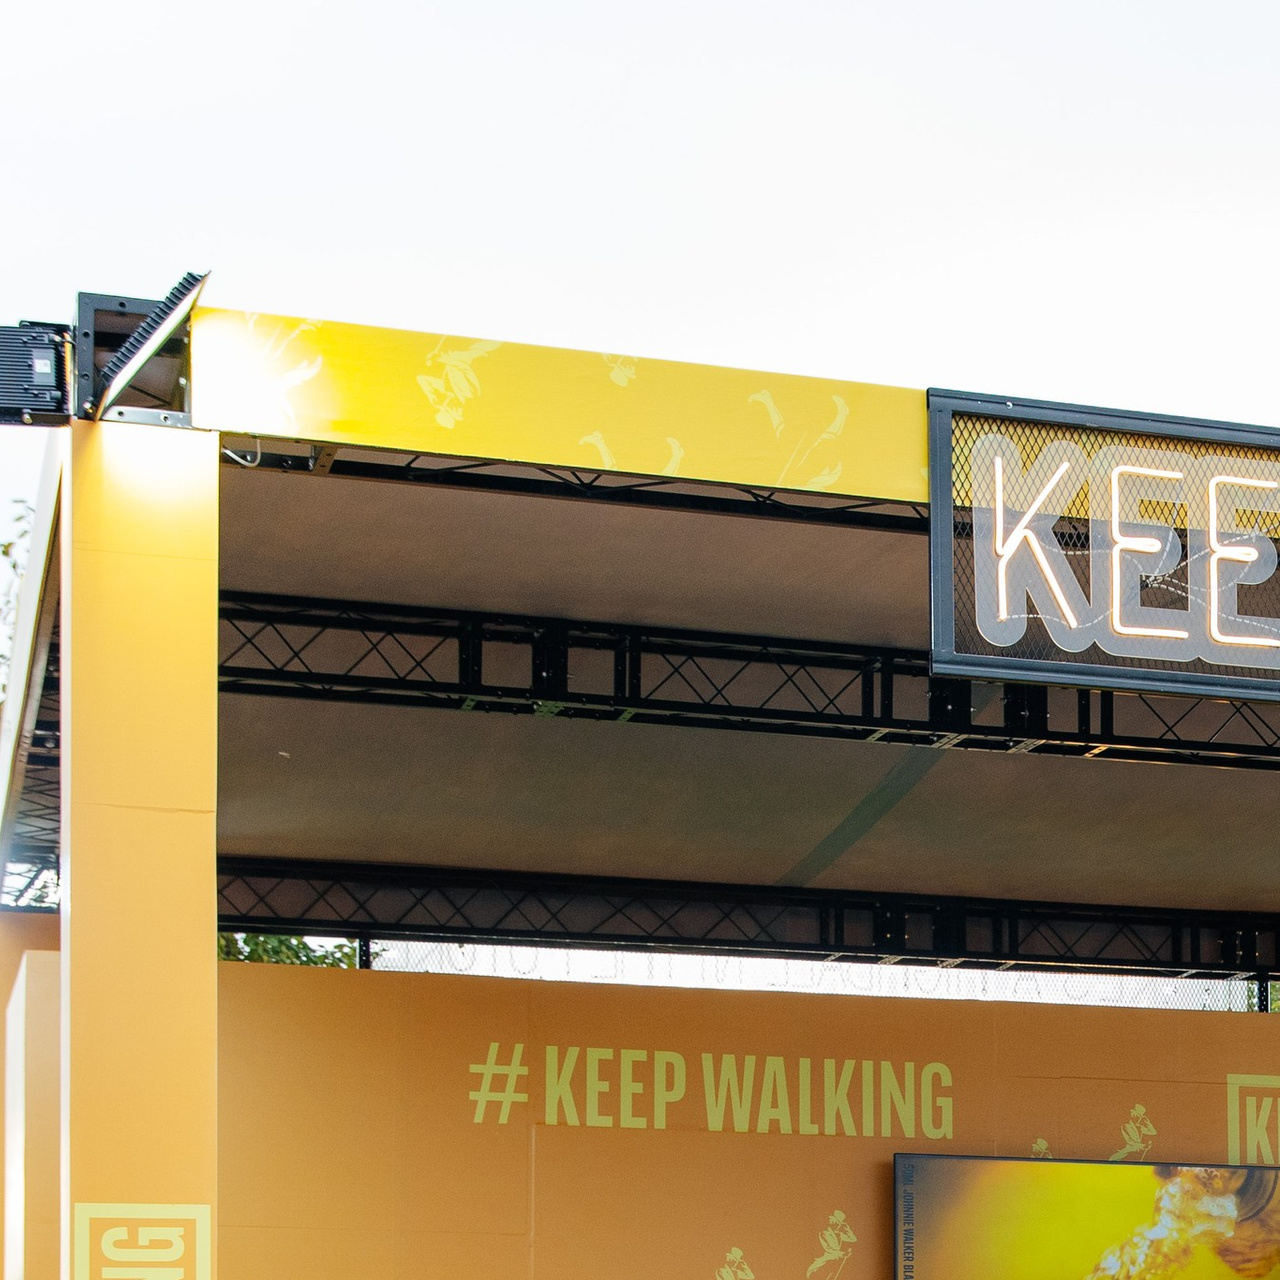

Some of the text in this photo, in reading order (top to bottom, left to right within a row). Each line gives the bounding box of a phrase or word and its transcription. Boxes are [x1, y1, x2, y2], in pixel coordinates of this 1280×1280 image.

[701, 1052, 954, 1140] WALKING
[902, 1189, 915, 1227] JOHNNIE
[902, 1228, 915, 1262] WALKER
